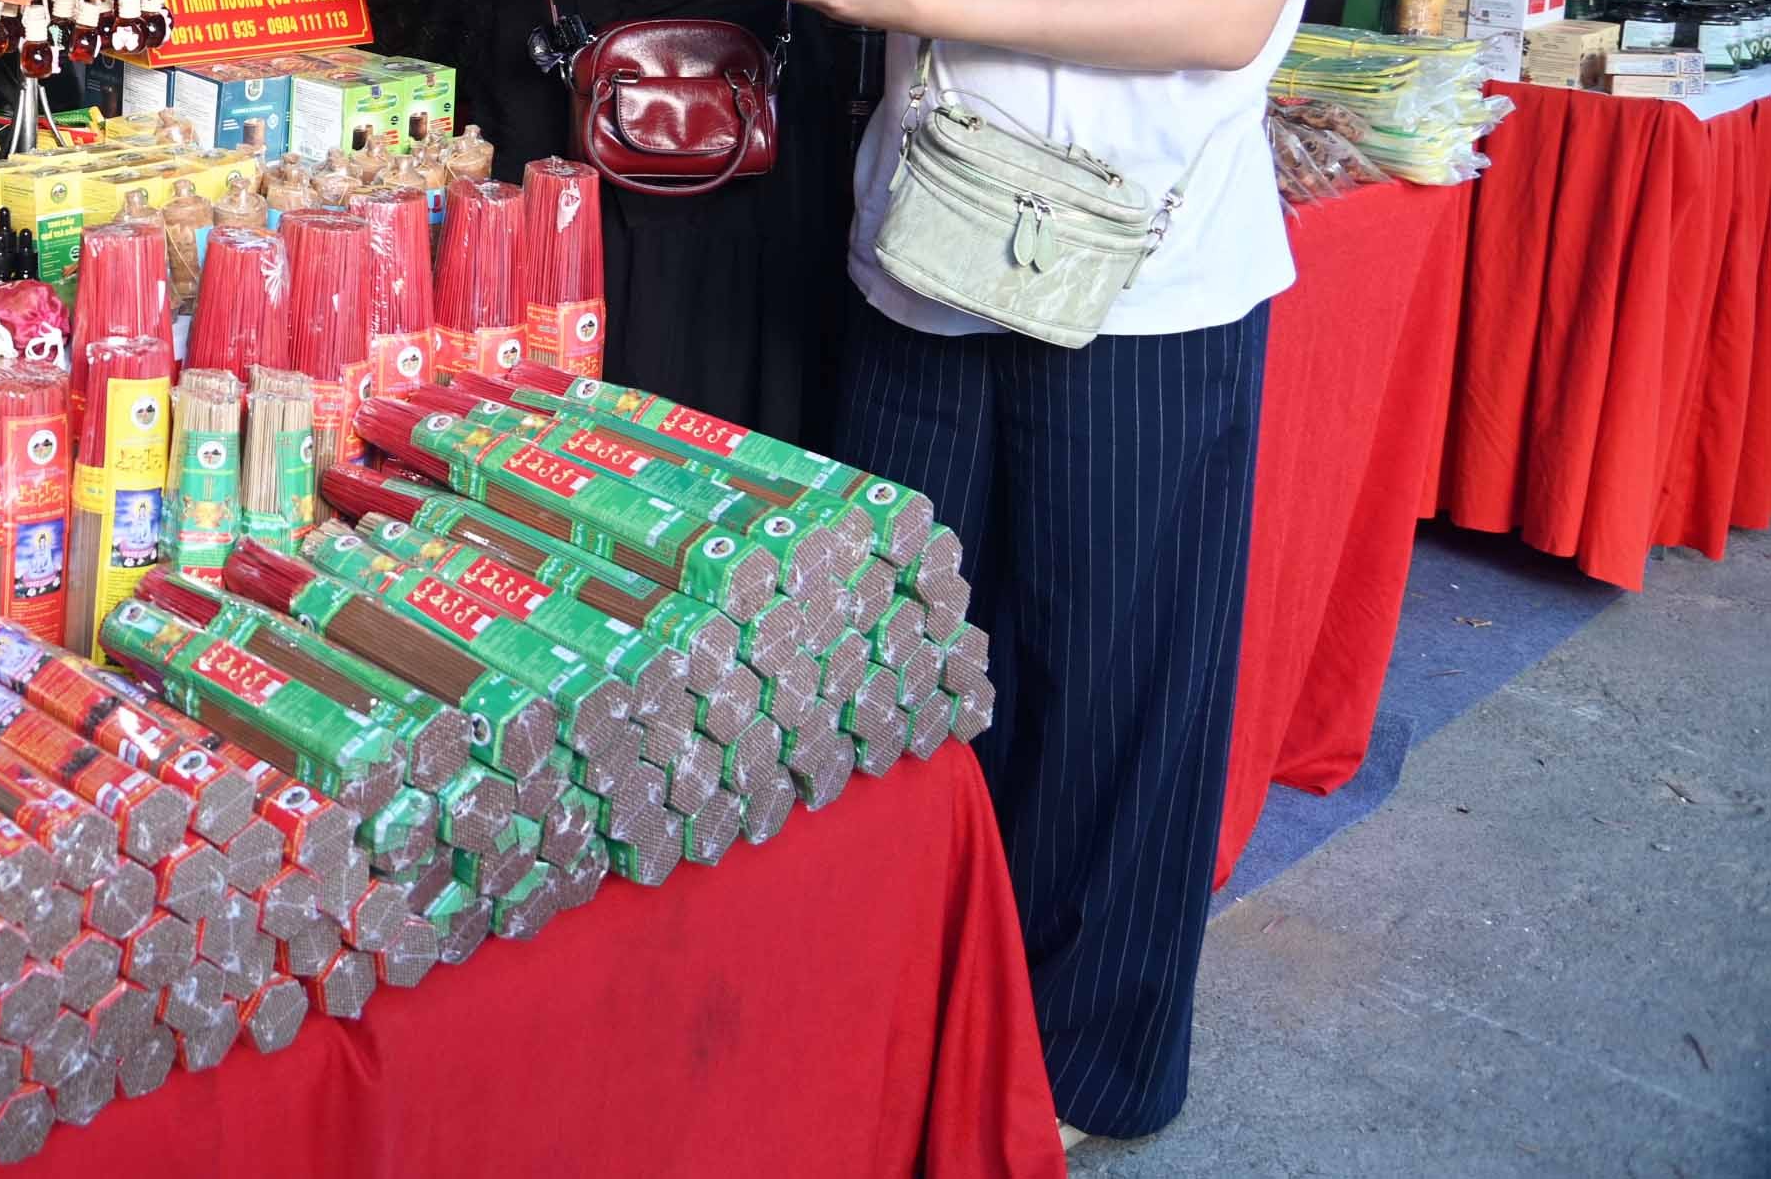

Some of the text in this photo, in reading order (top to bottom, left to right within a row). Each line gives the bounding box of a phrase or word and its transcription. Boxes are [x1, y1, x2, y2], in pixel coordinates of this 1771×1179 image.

[170, 24, 204, 45] 0914
[206, 22, 230, 42] 101
[232, 19, 257, 40] 935
[267, 15, 299, 36] 0984
[300, 12, 323, 32] 111
[325, 10, 349, 29] 113
